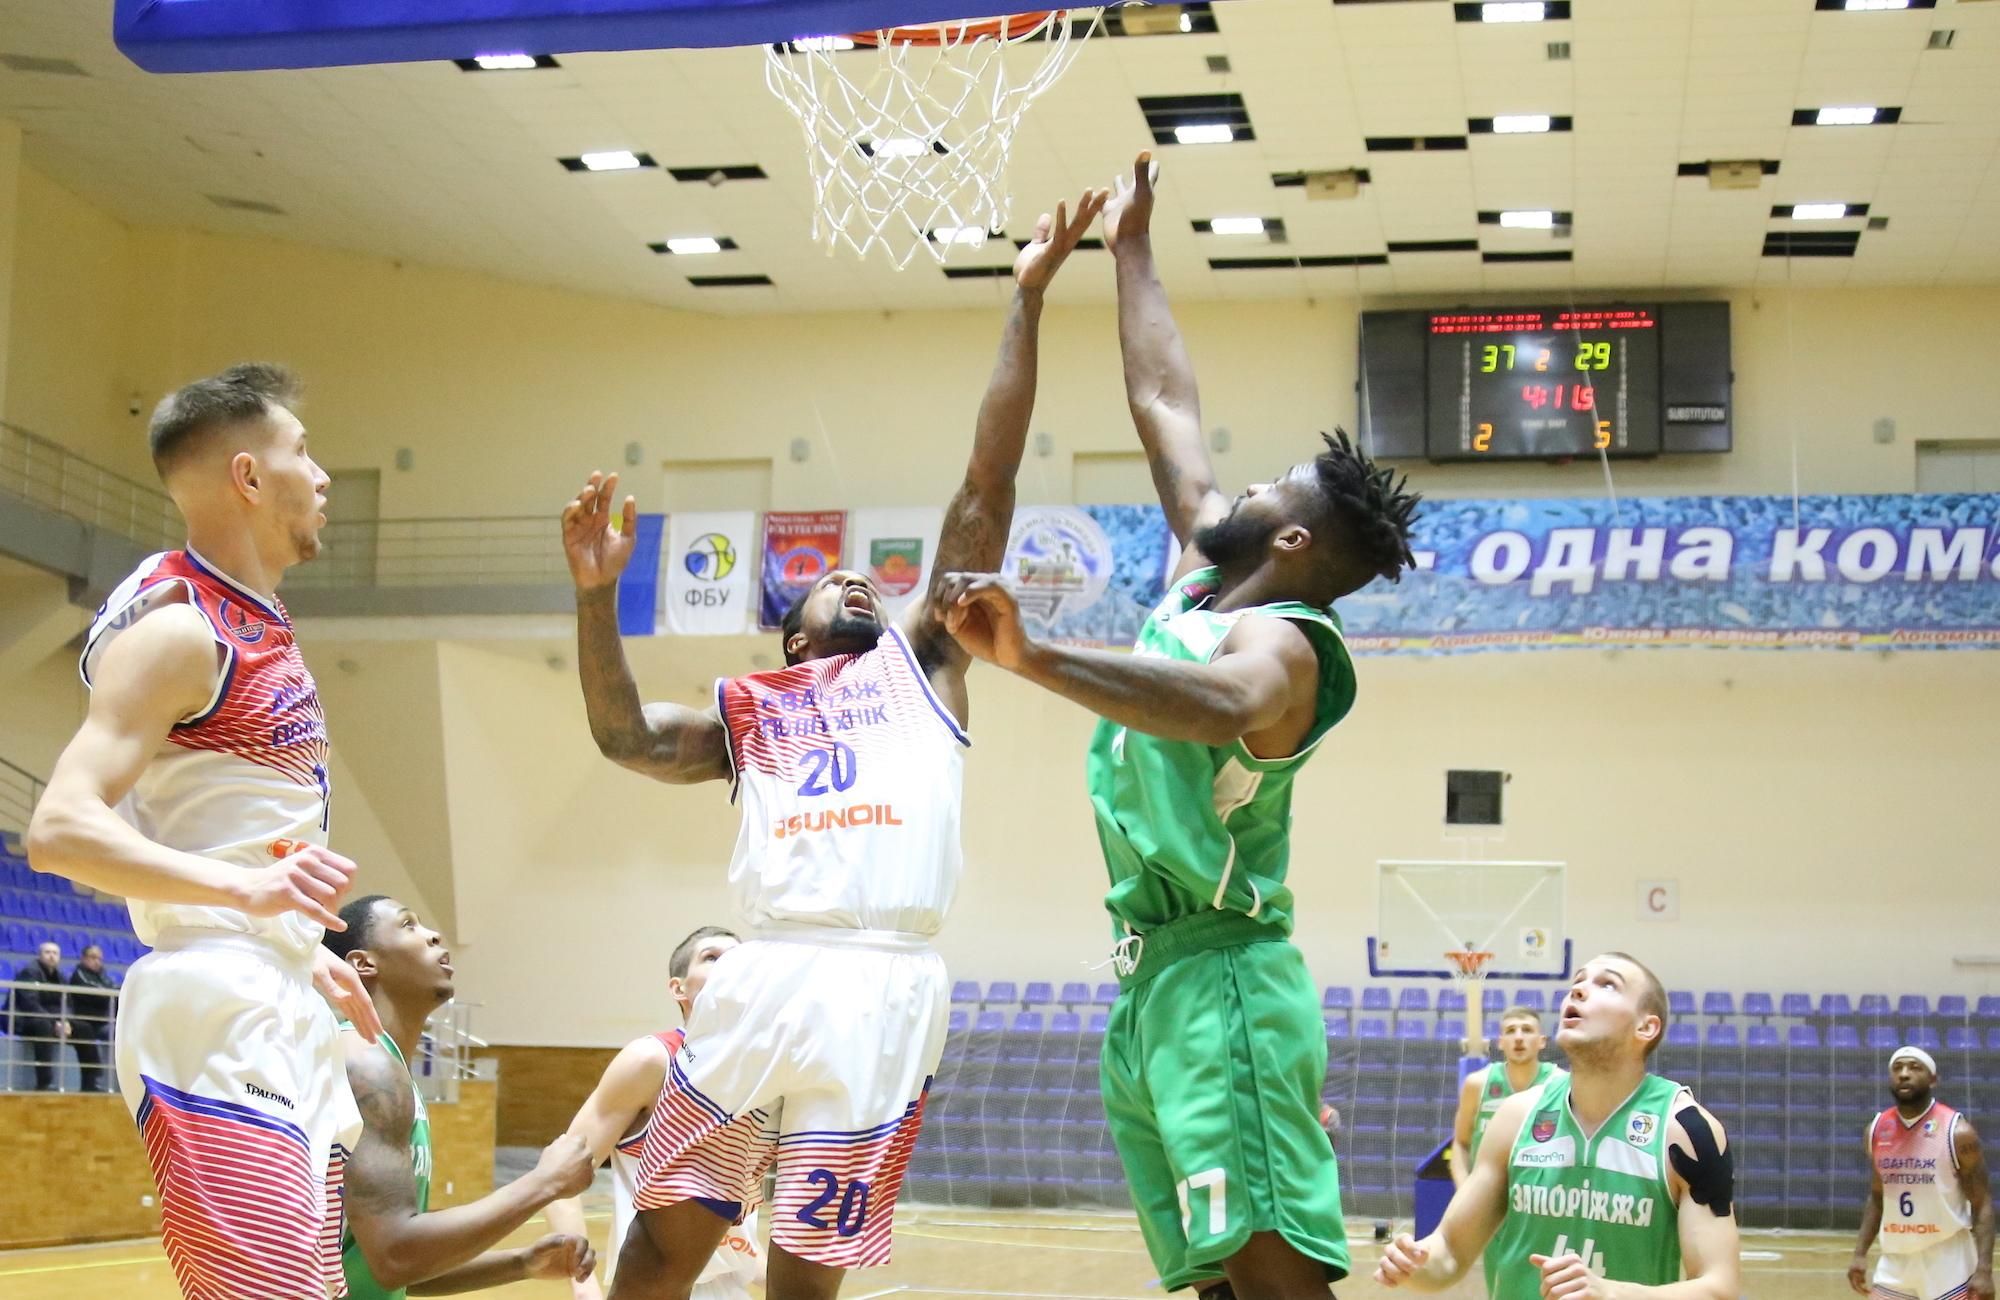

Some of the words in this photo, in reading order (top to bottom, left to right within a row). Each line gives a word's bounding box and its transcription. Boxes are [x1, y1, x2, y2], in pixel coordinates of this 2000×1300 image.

[1481, 344, 1516, 373] 37
[1574, 342, 1611, 371] 29
[1473, 422, 1493, 451] 2
[1594, 420, 1611, 449] 5
[1469, 527, 1734, 597] одна
[1768, 526, 2000, 583] ком
[684, 588, 731, 608] ФБУ
[797, 741, 857, 797] 20
[787, 804, 903, 837] SUNOIL
[244, 1082, 295, 1111] SPALDING
[1628, 1134, 1649, 1144] ФБУ
[796, 1168, 870, 1237] 20
[1899, 1191, 1914, 1217] 6
